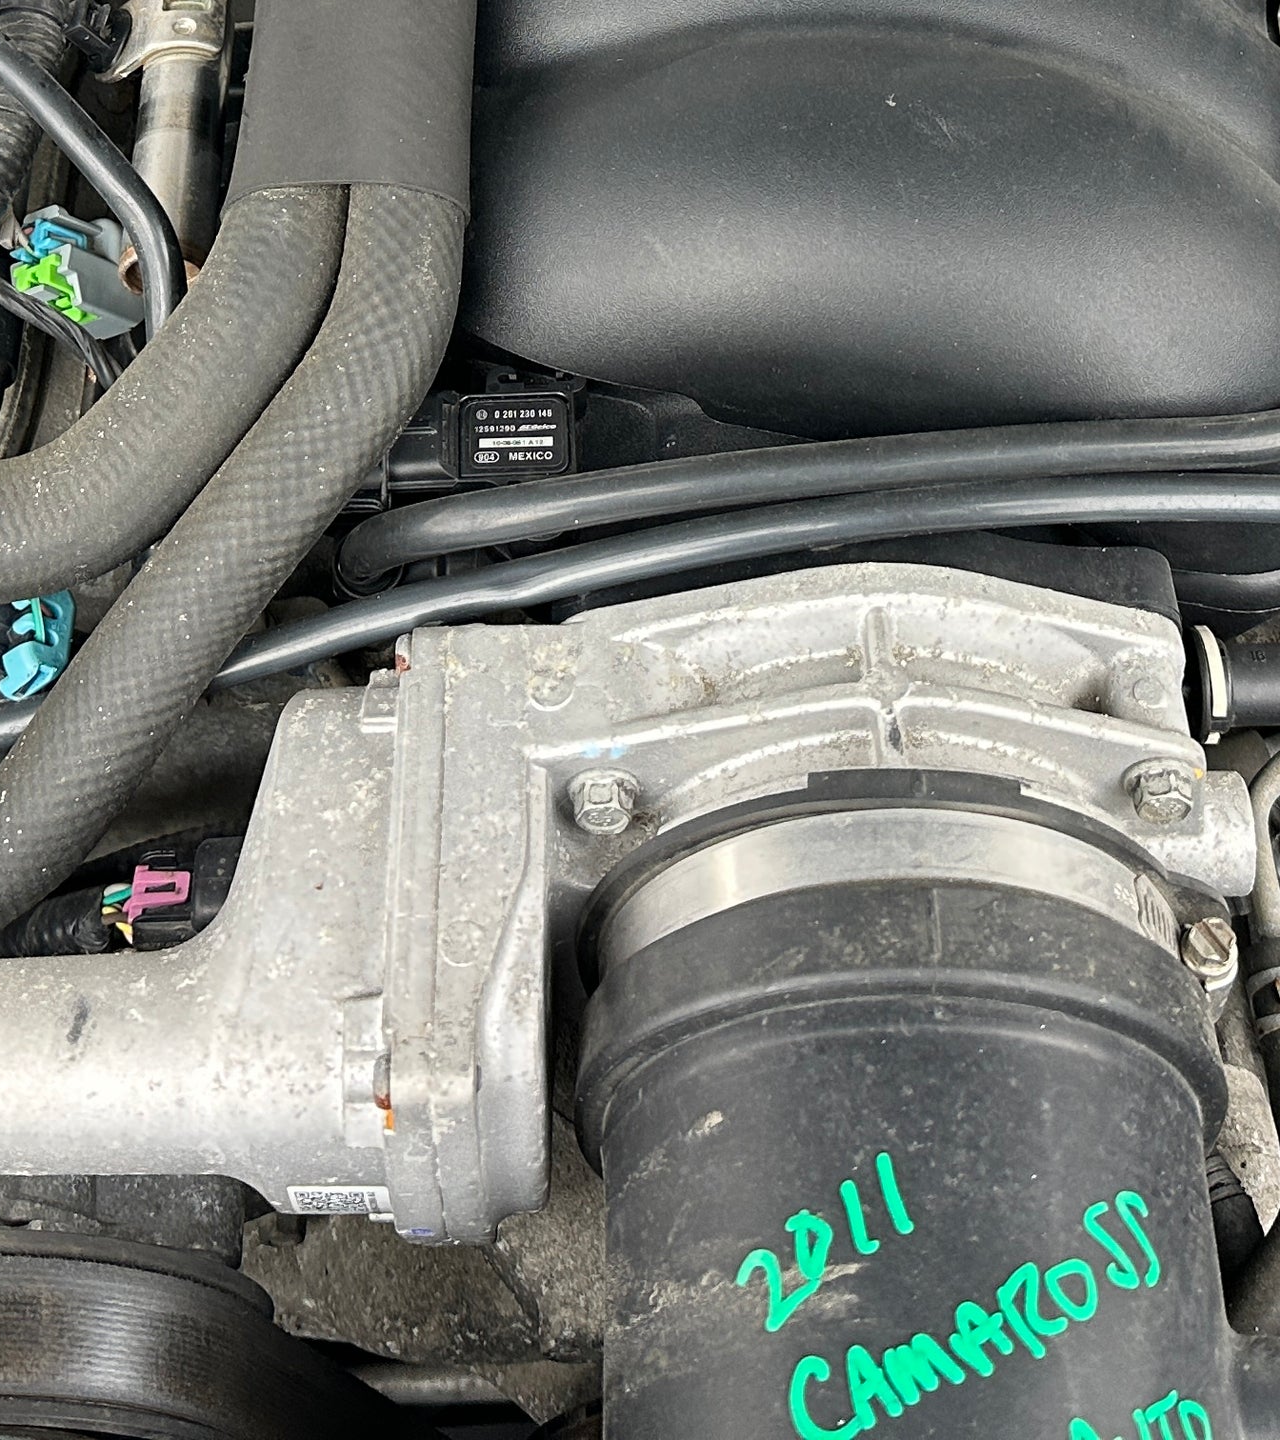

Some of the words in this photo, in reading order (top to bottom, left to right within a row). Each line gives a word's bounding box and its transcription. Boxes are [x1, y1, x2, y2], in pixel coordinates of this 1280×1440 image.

[508, 451, 553, 461] MEXICO
[520, 409, 536, 418] 230
[736, 1151, 915, 1332] 2011
[788, 1257, 1099, 1440] CAMARO
[1083, 1190, 1161, 1290] SS
